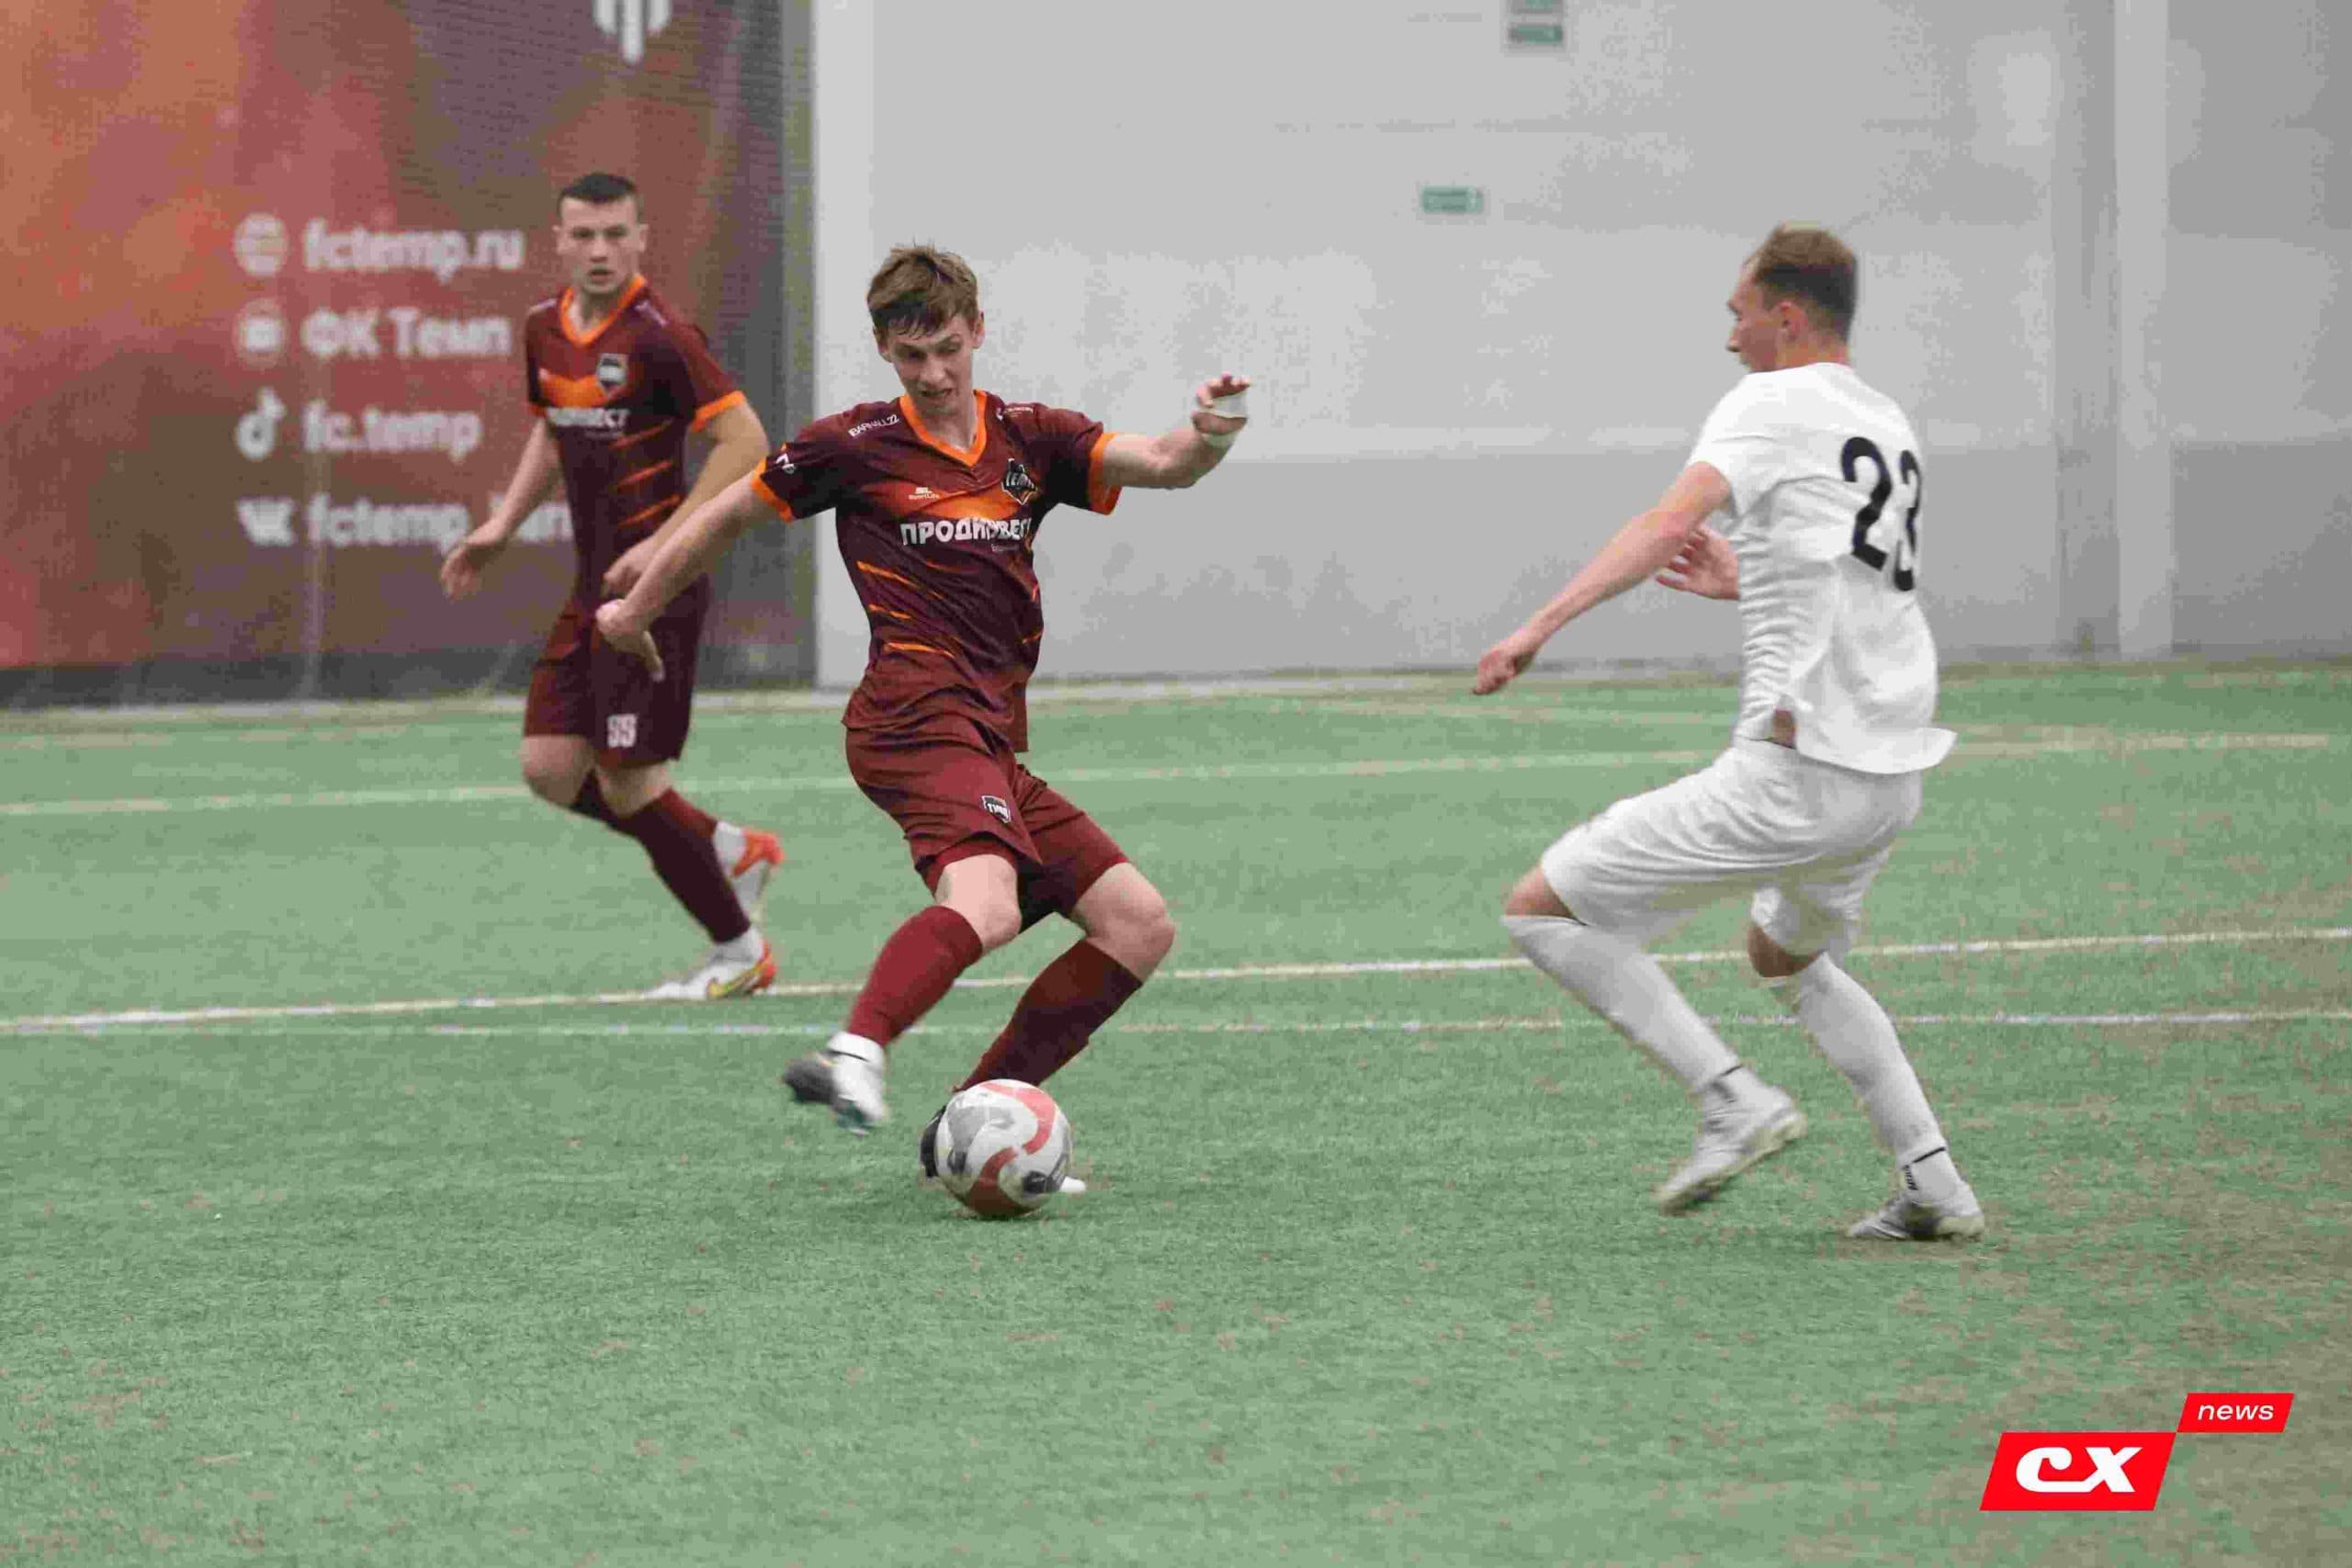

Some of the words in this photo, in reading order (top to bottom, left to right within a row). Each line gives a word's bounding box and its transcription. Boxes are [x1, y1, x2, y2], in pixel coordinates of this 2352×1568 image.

[302, 217, 525, 283] fctemp.ru
[300, 307, 380, 359] ФК
[386, 307, 512, 359] Темп
[302, 399, 483, 463] fc.temp
[1840, 436, 1922, 592] 23
